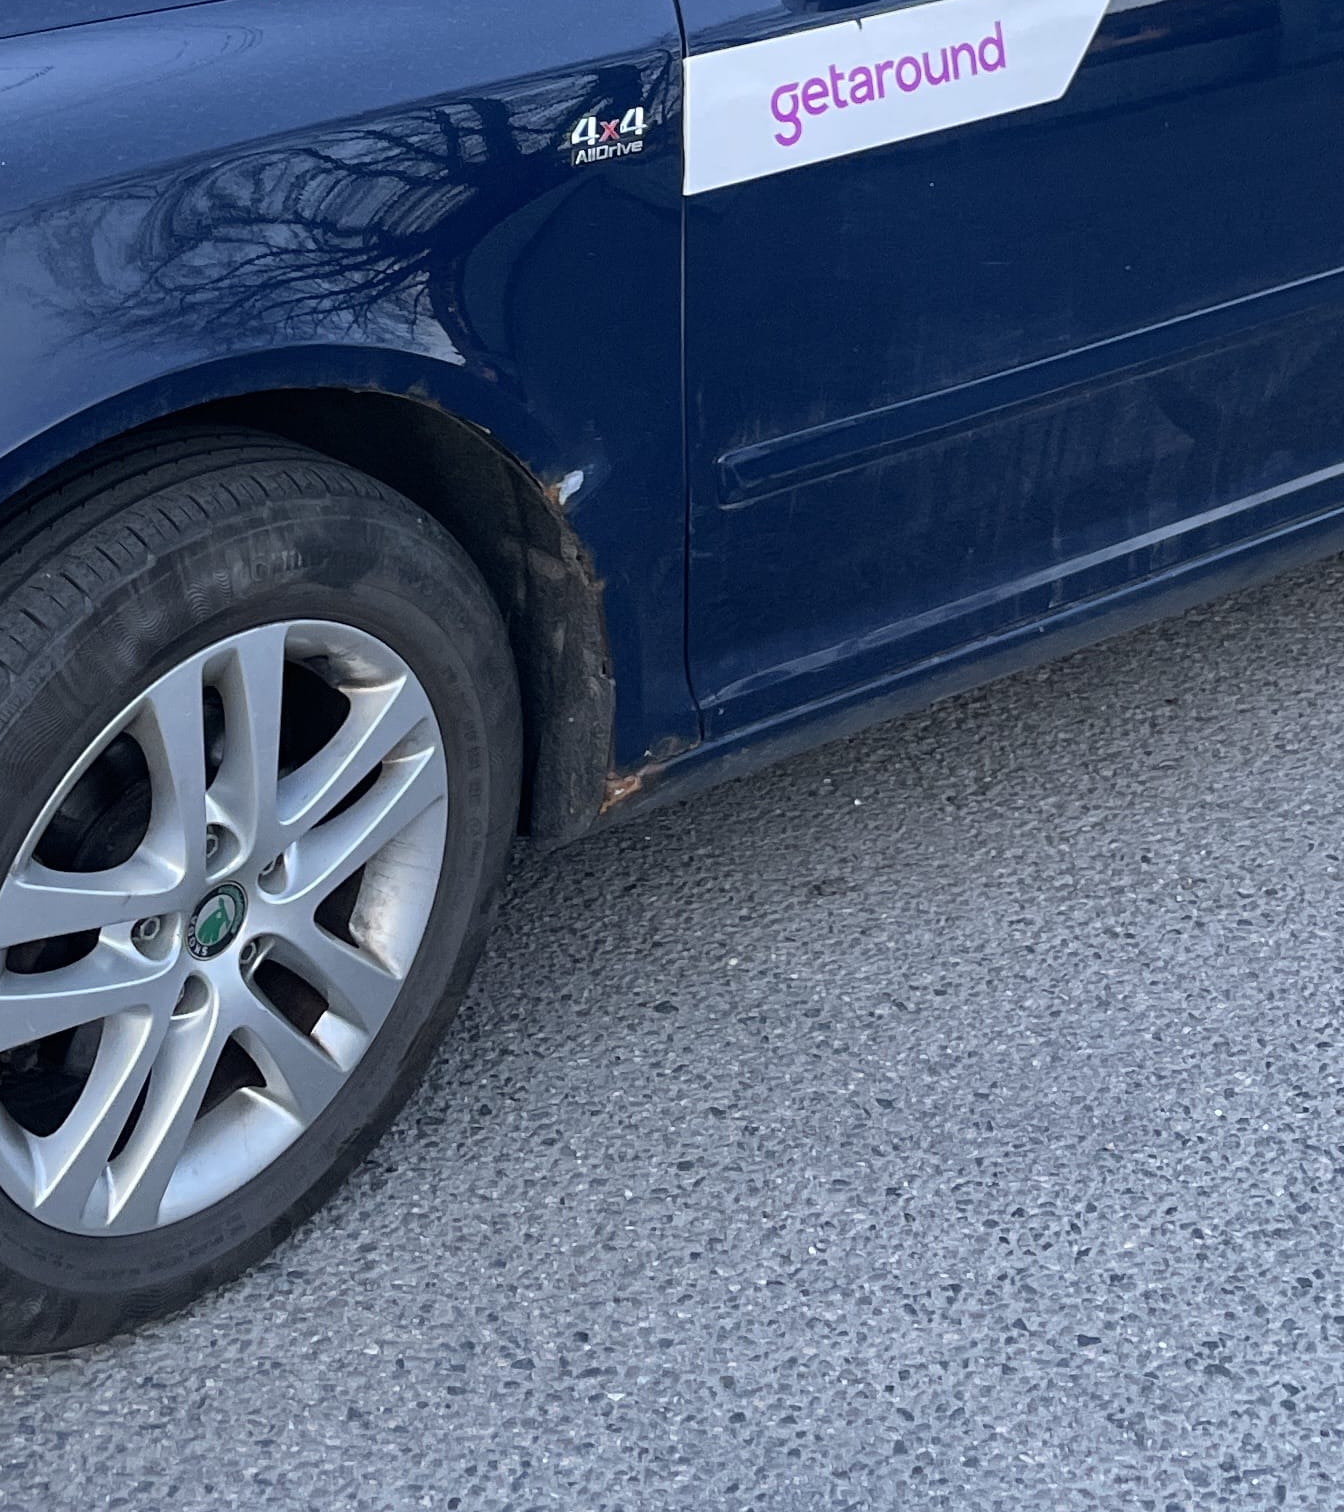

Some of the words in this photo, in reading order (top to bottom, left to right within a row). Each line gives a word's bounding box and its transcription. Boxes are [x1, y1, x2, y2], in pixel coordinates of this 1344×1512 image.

[770, 21, 1006, 147] getaround
[571, 106, 648, 145] 4x4
[575, 140, 643, 165] AllDrive
